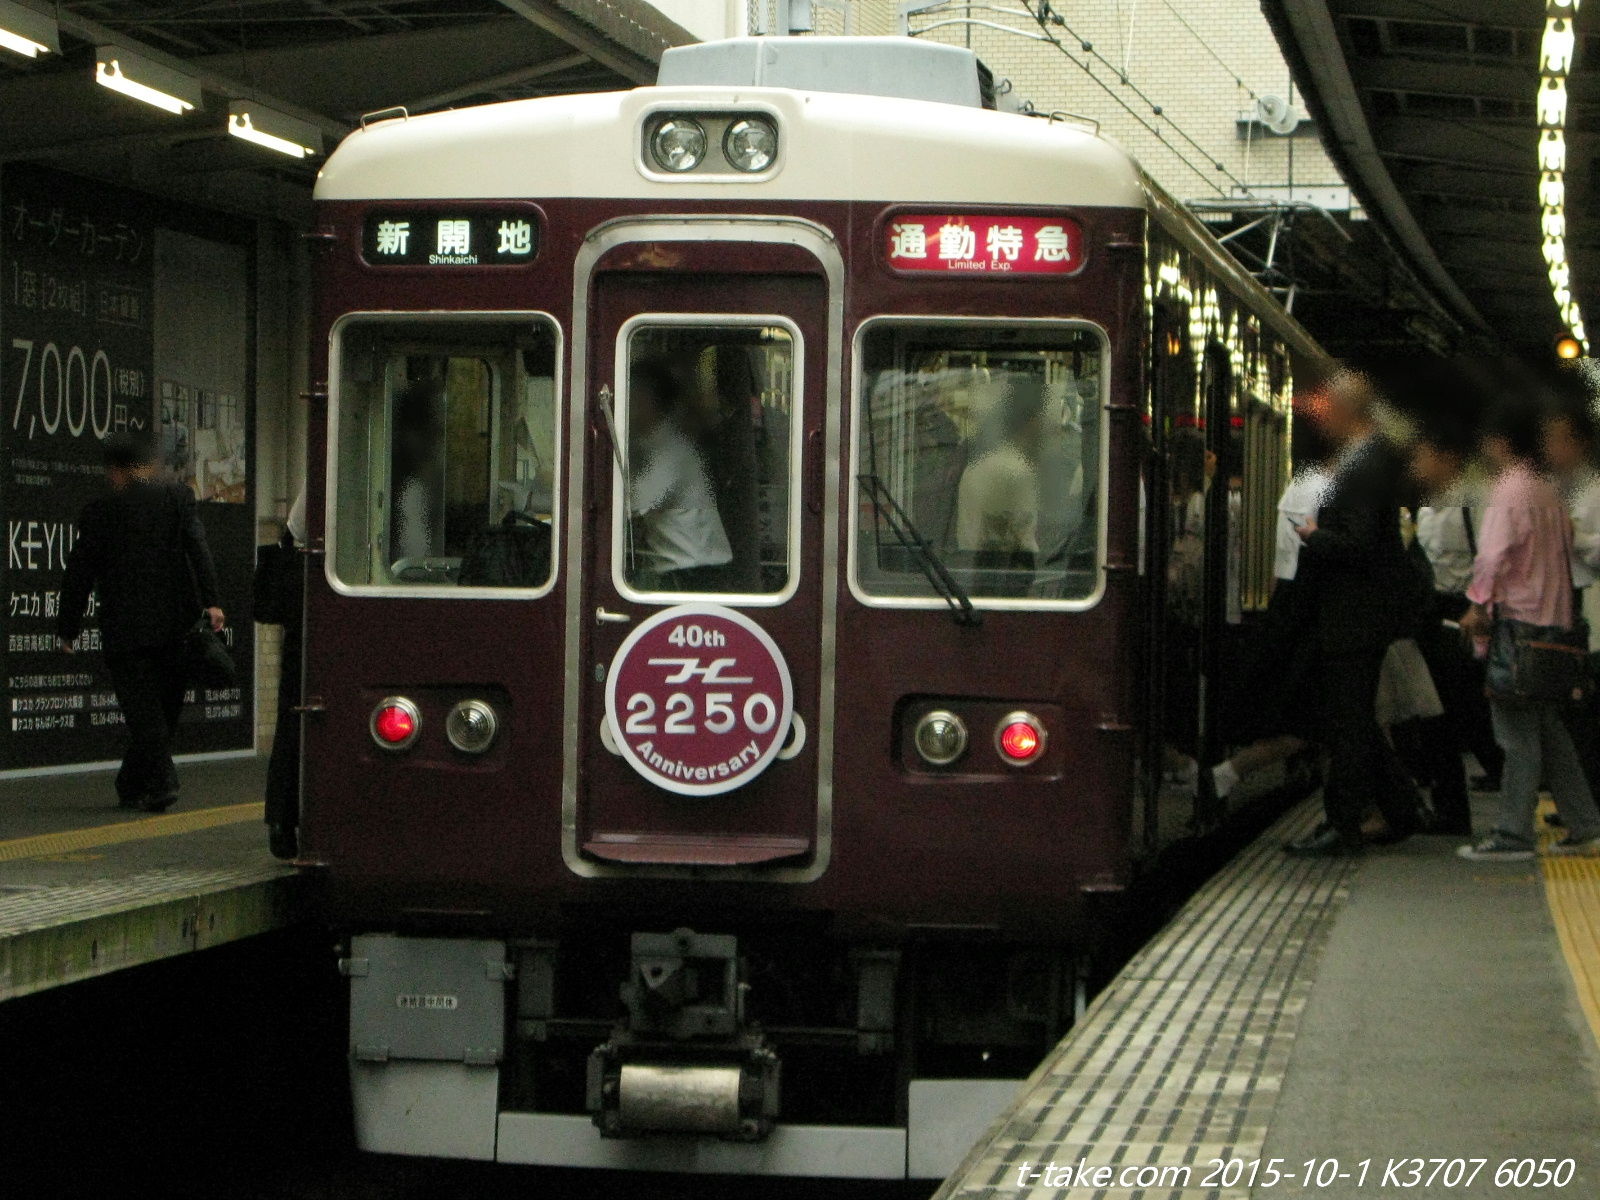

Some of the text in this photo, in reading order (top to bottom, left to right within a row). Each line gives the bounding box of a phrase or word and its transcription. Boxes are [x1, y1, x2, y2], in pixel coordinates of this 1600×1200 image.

[12, 199, 144, 263] オーダーカーテン
[376, 220, 532, 255] 新開地
[890, 223, 1071, 262] 通勤特急
[428, 254, 478, 265] Shinkaichi
[948, 260, 1013, 272] Limited Exp.
[12, 338, 112, 440] 7,000
[9, 520, 80, 571] KEYU
[10, 591, 40, 617] ケユカ
[668, 625, 725, 647] 40th
[625, 692, 776, 734] 2250
[636, 739, 763, 781] Anniversary
